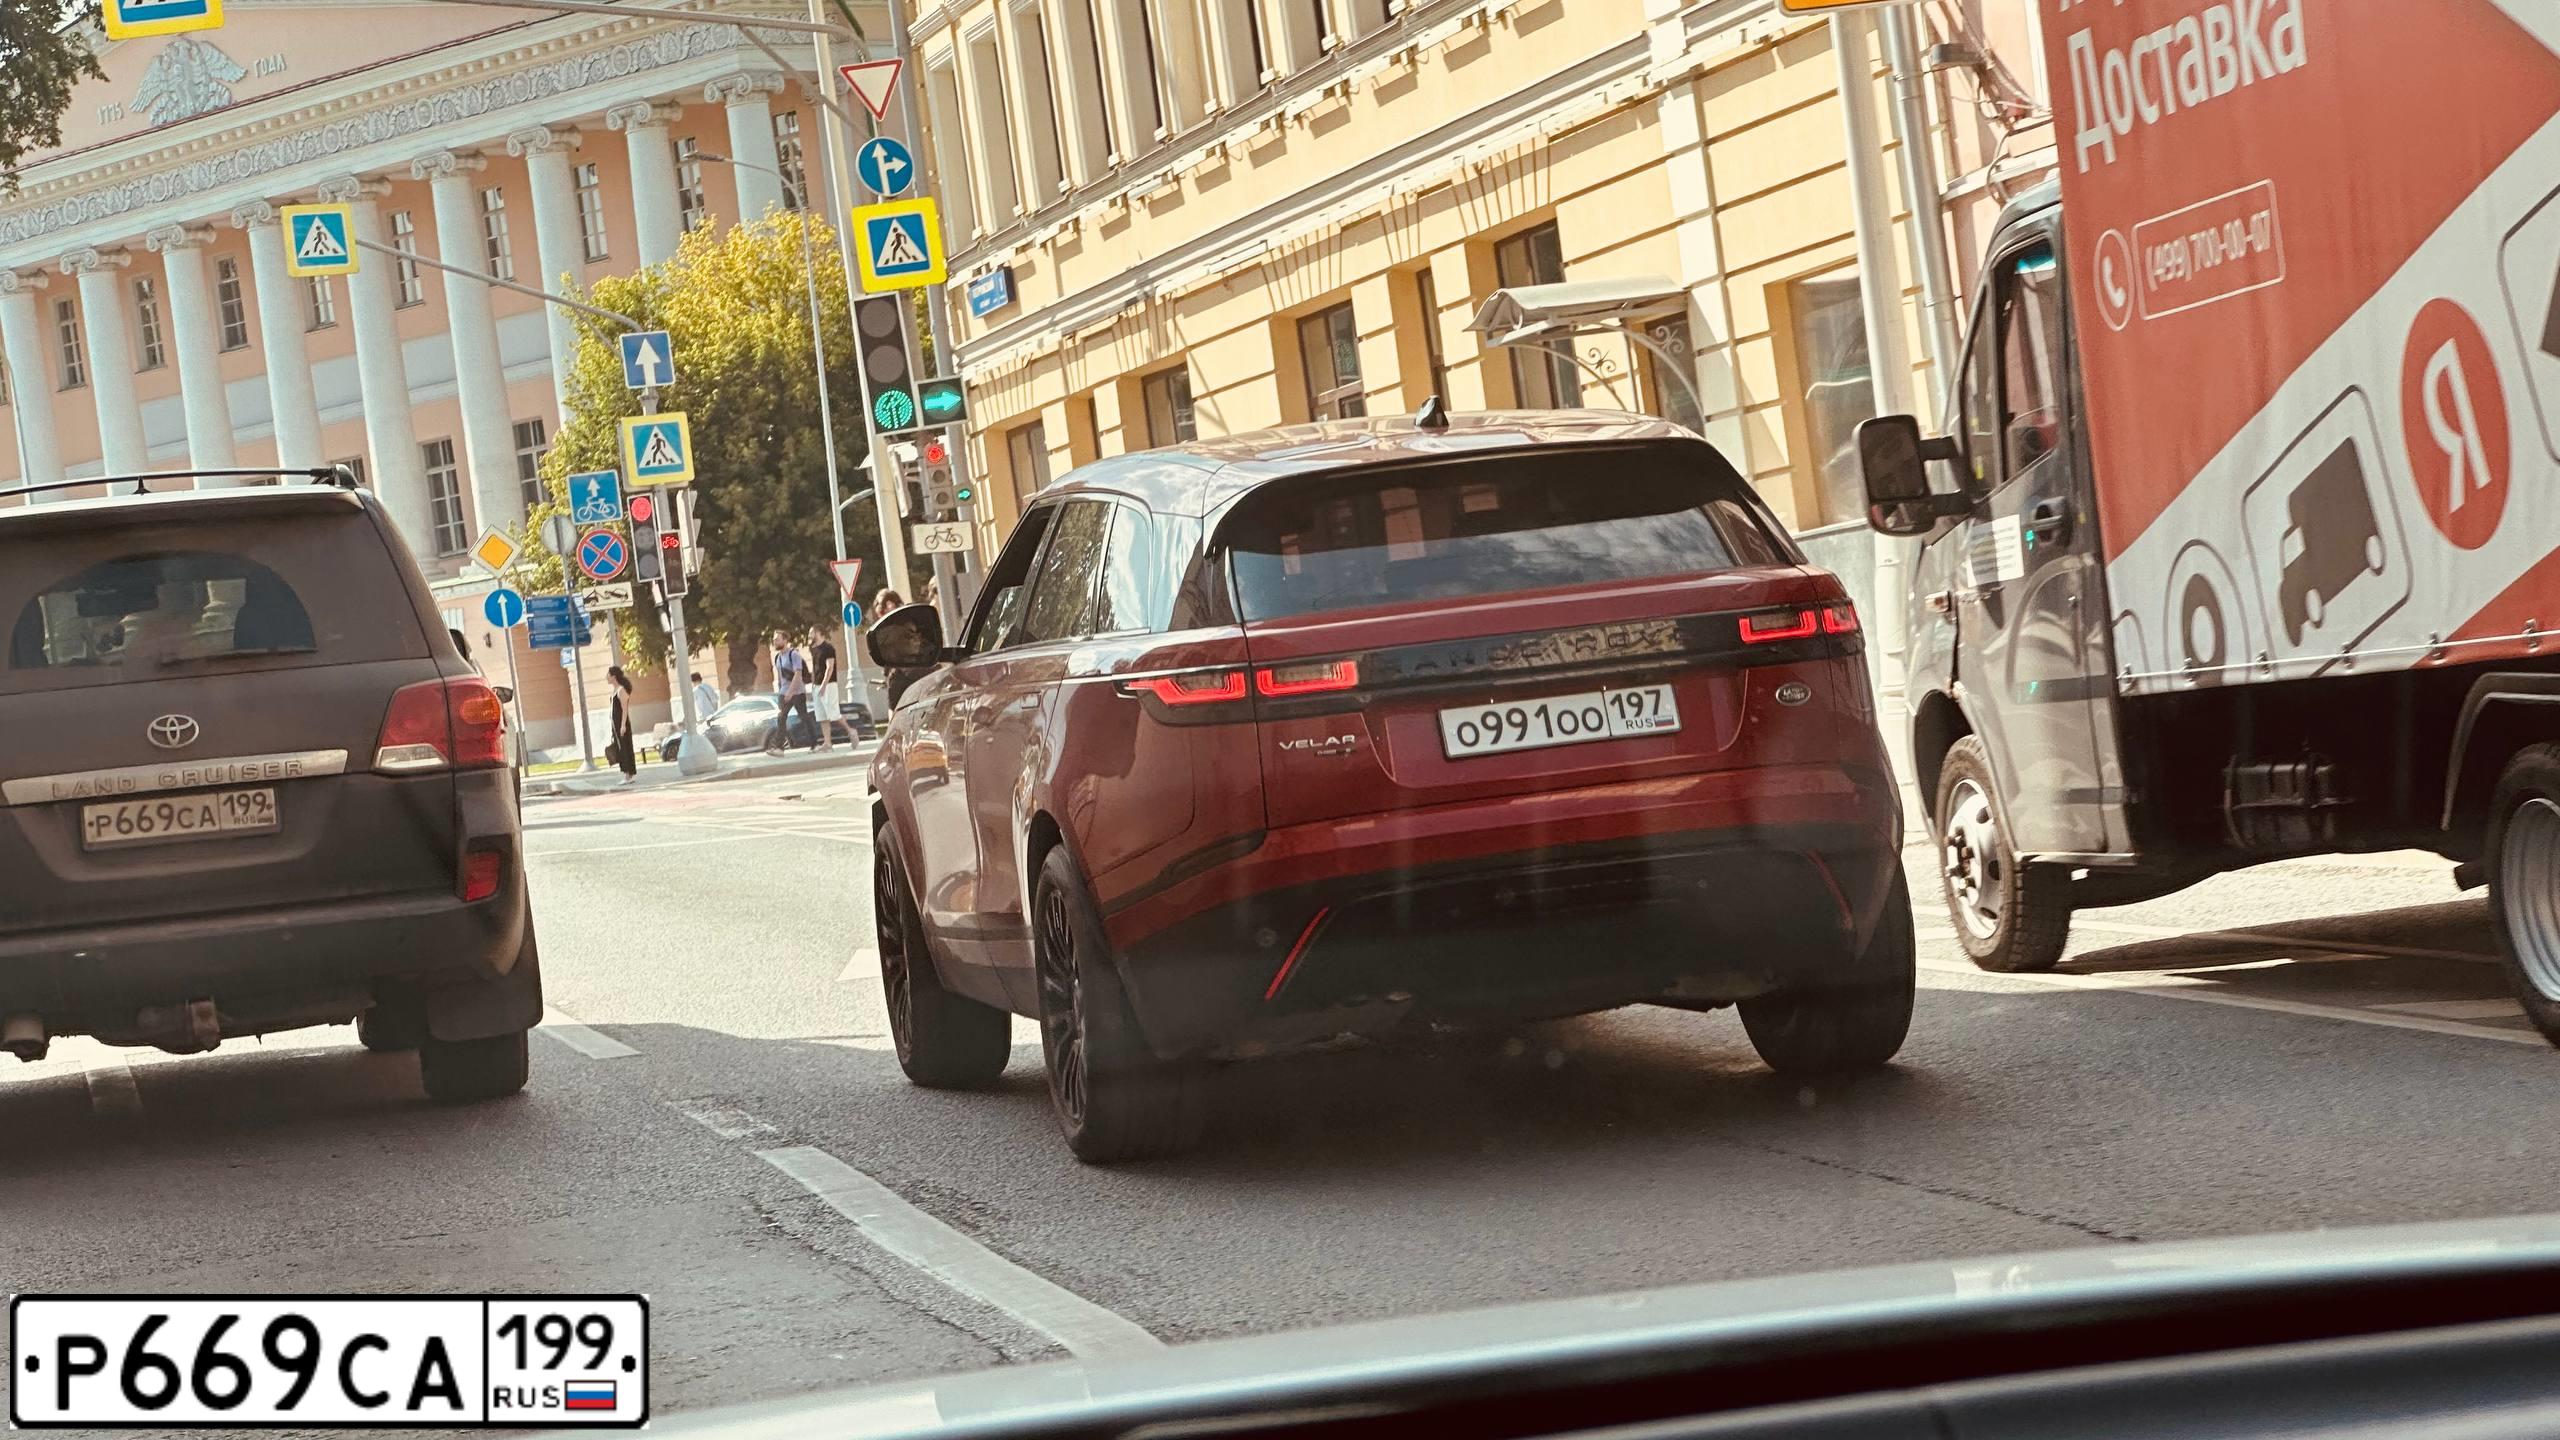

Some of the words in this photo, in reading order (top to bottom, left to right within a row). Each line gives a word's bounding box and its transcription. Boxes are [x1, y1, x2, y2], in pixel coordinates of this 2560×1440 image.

[2067, 0, 2307, 174] Доставка
[2145, 235, 2192, 292] (499)
[2421, 337, 2492, 514] Я
[1610, 689, 1661, 719] 197
[1625, 718, 1653, 730] RUS
[1279, 735, 1355, 750] VELAR
[51, 776, 136, 800] LAND
[158, 760, 303, 788] CRUISER
[223, 792, 267, 817] 199
